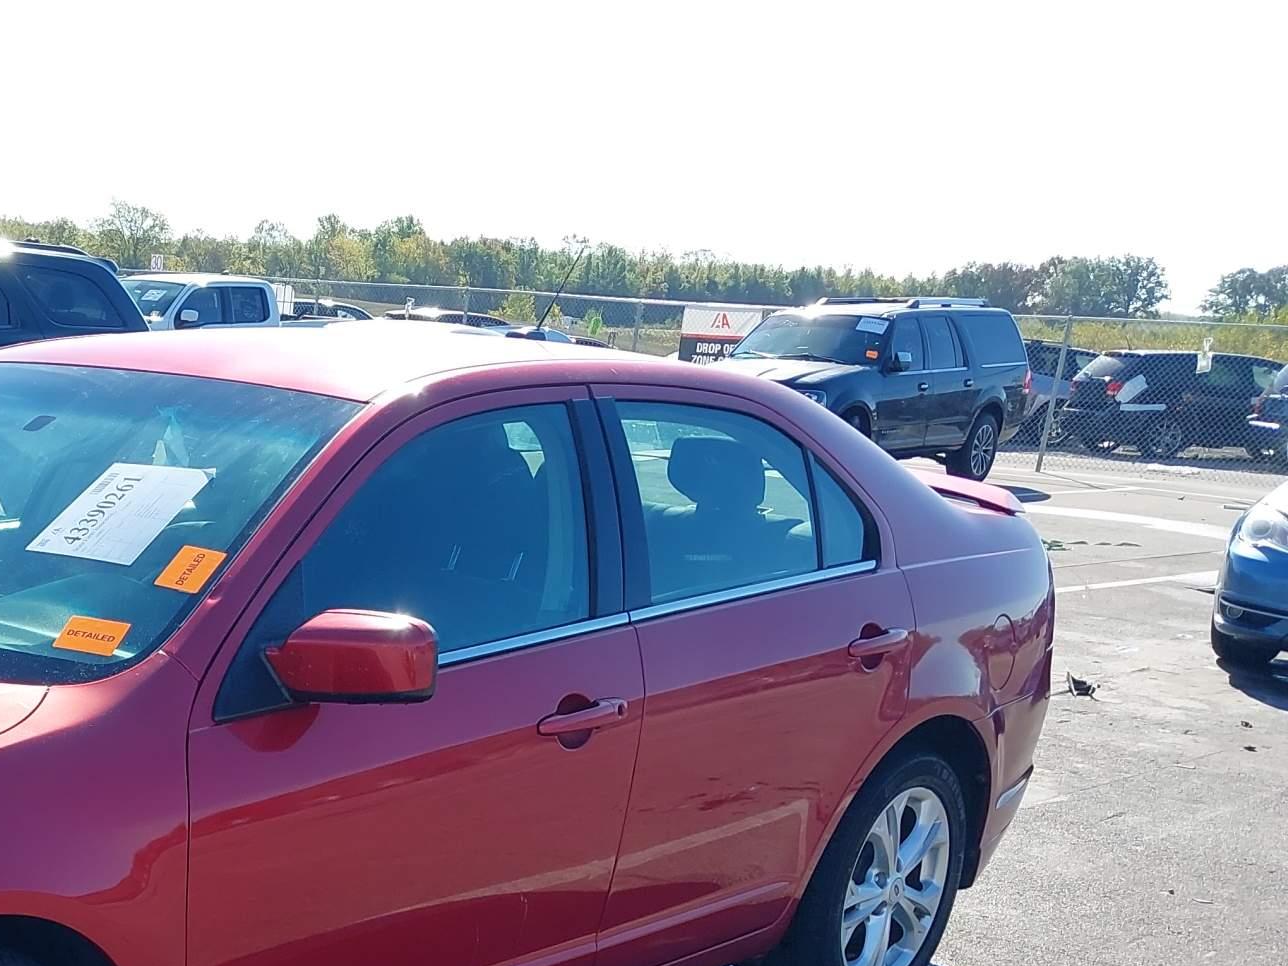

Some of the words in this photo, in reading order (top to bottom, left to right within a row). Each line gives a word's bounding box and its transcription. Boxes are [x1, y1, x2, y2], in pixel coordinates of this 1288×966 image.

[696, 342, 722, 354] DROP
[63, 475, 144, 546] 43390261
[175, 552, 206, 587] DETAILED
[66, 628, 116, 643] DETAILED
